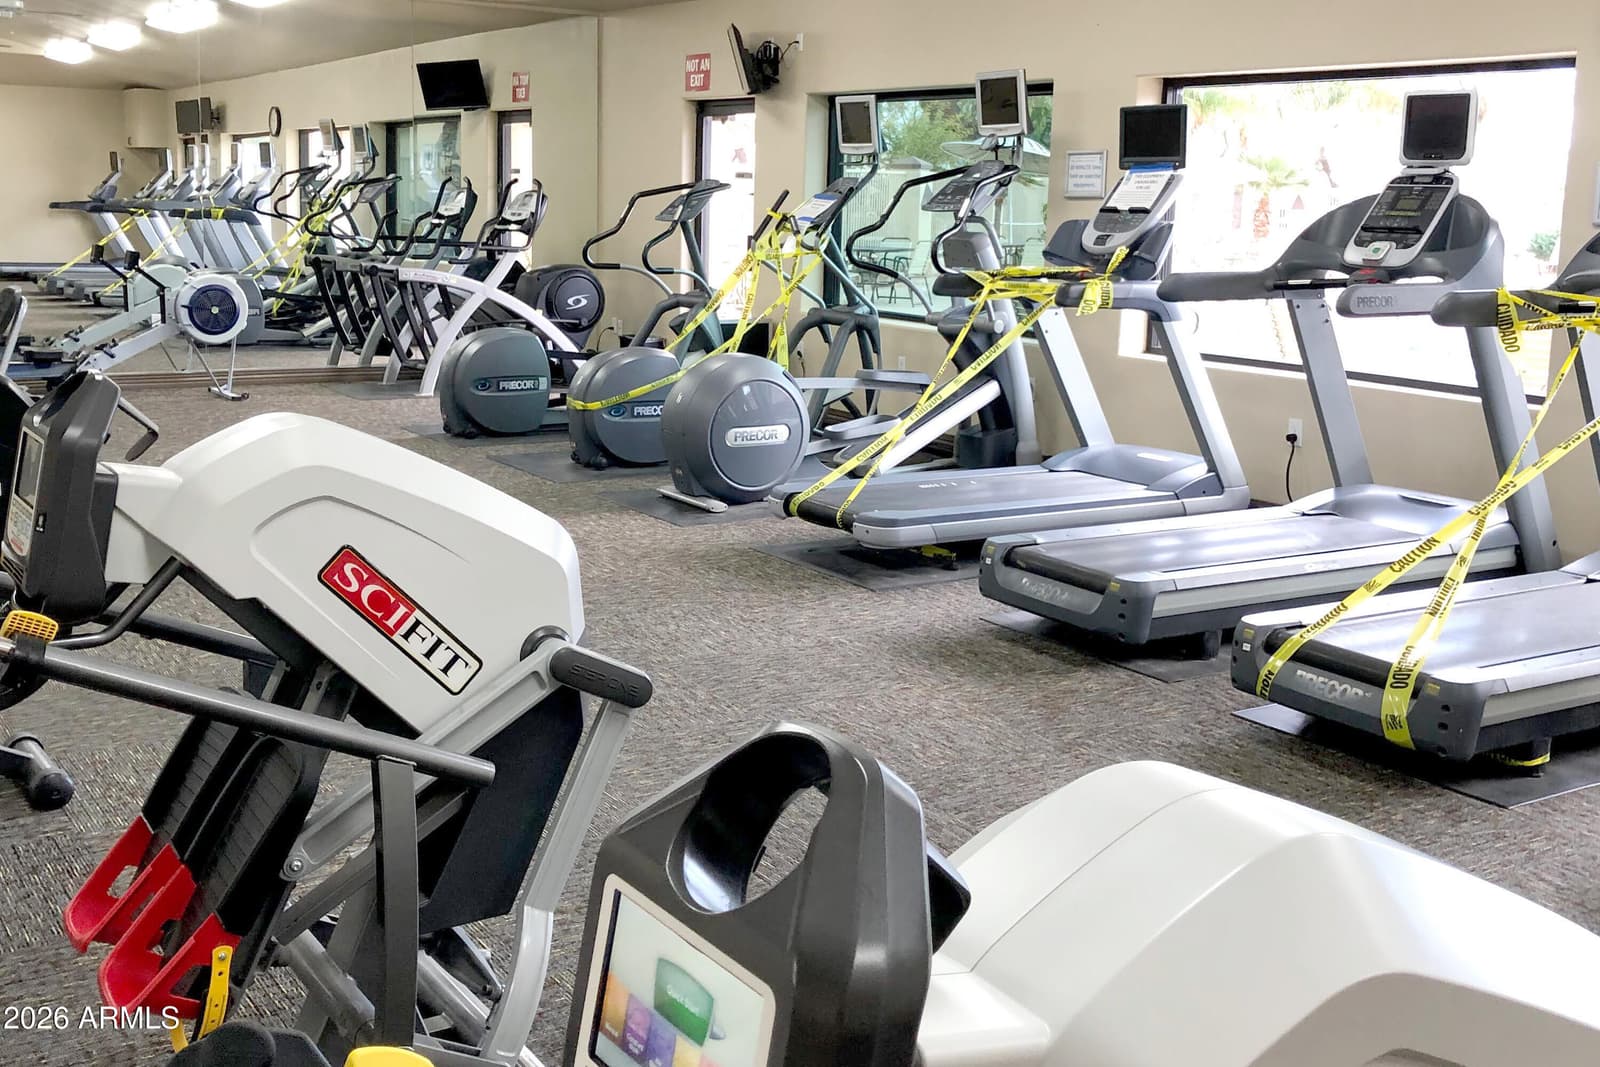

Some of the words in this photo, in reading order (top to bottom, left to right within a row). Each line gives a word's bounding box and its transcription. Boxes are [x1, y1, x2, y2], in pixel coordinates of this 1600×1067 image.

[686, 59, 699, 73] NOT
[700, 57, 710, 72] AN
[690, 73, 705, 87] EXIT
[1497, 303, 1521, 353] CUIDADO
[499, 380, 535, 390] PRECOR
[734, 429, 779, 443] PRECOR
[1389, 536, 1441, 574] CAUTION
[333, 562, 469, 678] SCIFIT
